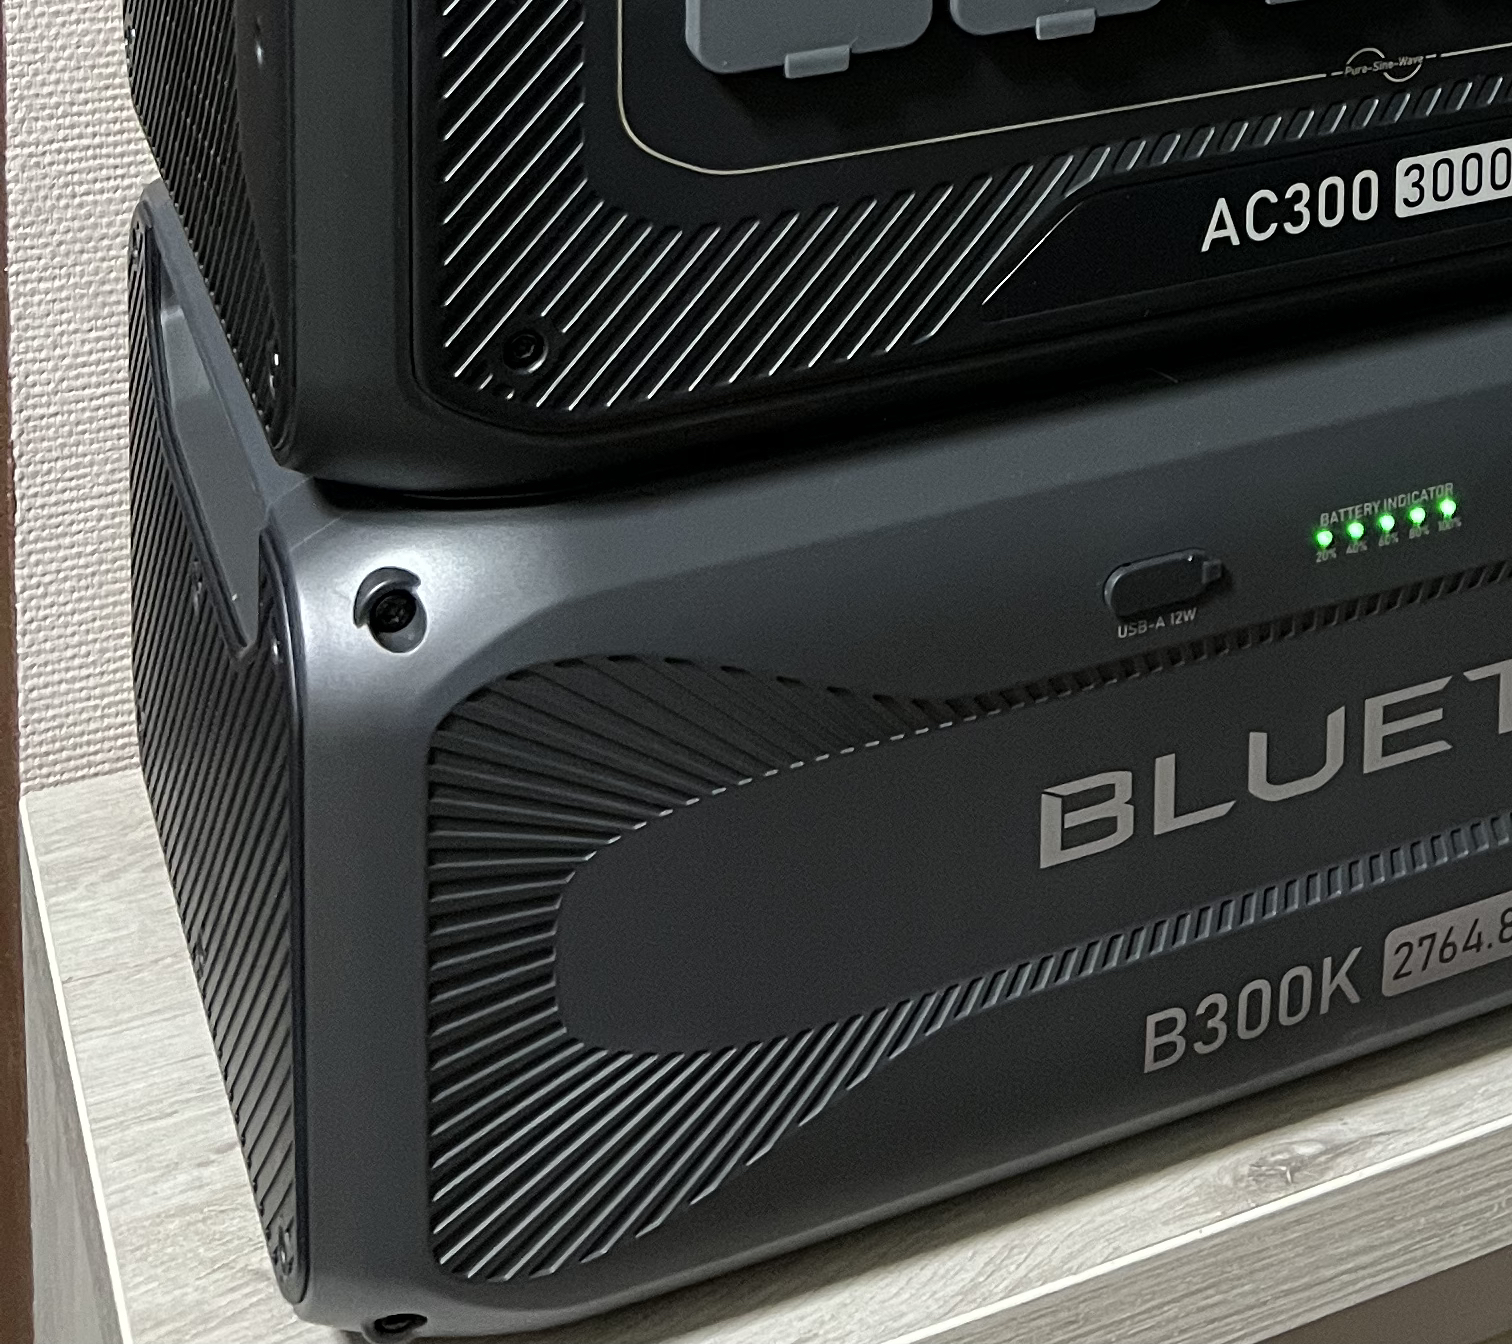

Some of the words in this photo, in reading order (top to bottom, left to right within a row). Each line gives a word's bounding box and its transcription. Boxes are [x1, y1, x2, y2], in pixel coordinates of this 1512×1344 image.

[1201, 169, 1380, 253] AC300
[1320, 500, 1381, 526] BATTERY
[1383, 482, 1454, 512] INDICATOR
[1316, 547, 1337, 563] 20%
[1117, 615, 1166, 639] USB-A
[1170, 607, 1197, 626] 12W
[1144, 946, 1362, 1074] B300K
